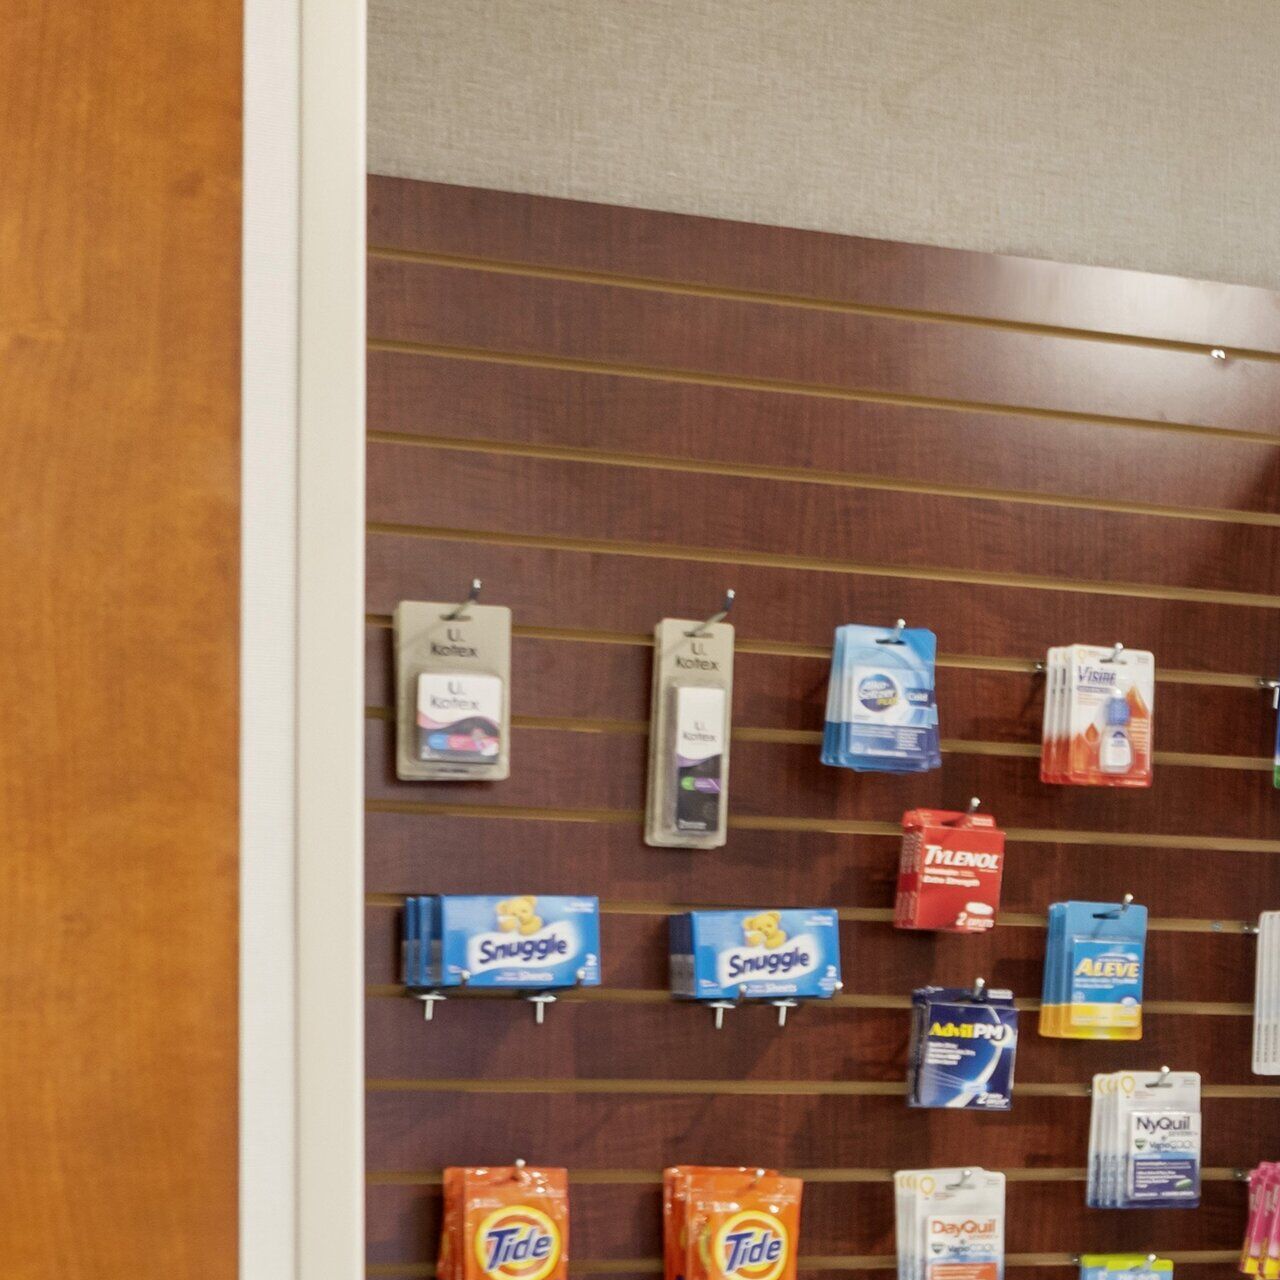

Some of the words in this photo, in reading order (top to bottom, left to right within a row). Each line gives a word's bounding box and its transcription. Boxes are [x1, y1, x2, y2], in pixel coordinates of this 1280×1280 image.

[924, 844, 1000, 869] TYLENOL
[479, 932, 569, 965] Snuggle
[728, 947, 811, 979] Snuggle
[1074, 957, 1140, 979] ALEVE
[1136, 1116, 1191, 1135] NyQuil
[932, 1219, 997, 1238] DayQuil
[487, 1227, 553, 1272] Tide
[725, 1231, 782, 1273] Tide
